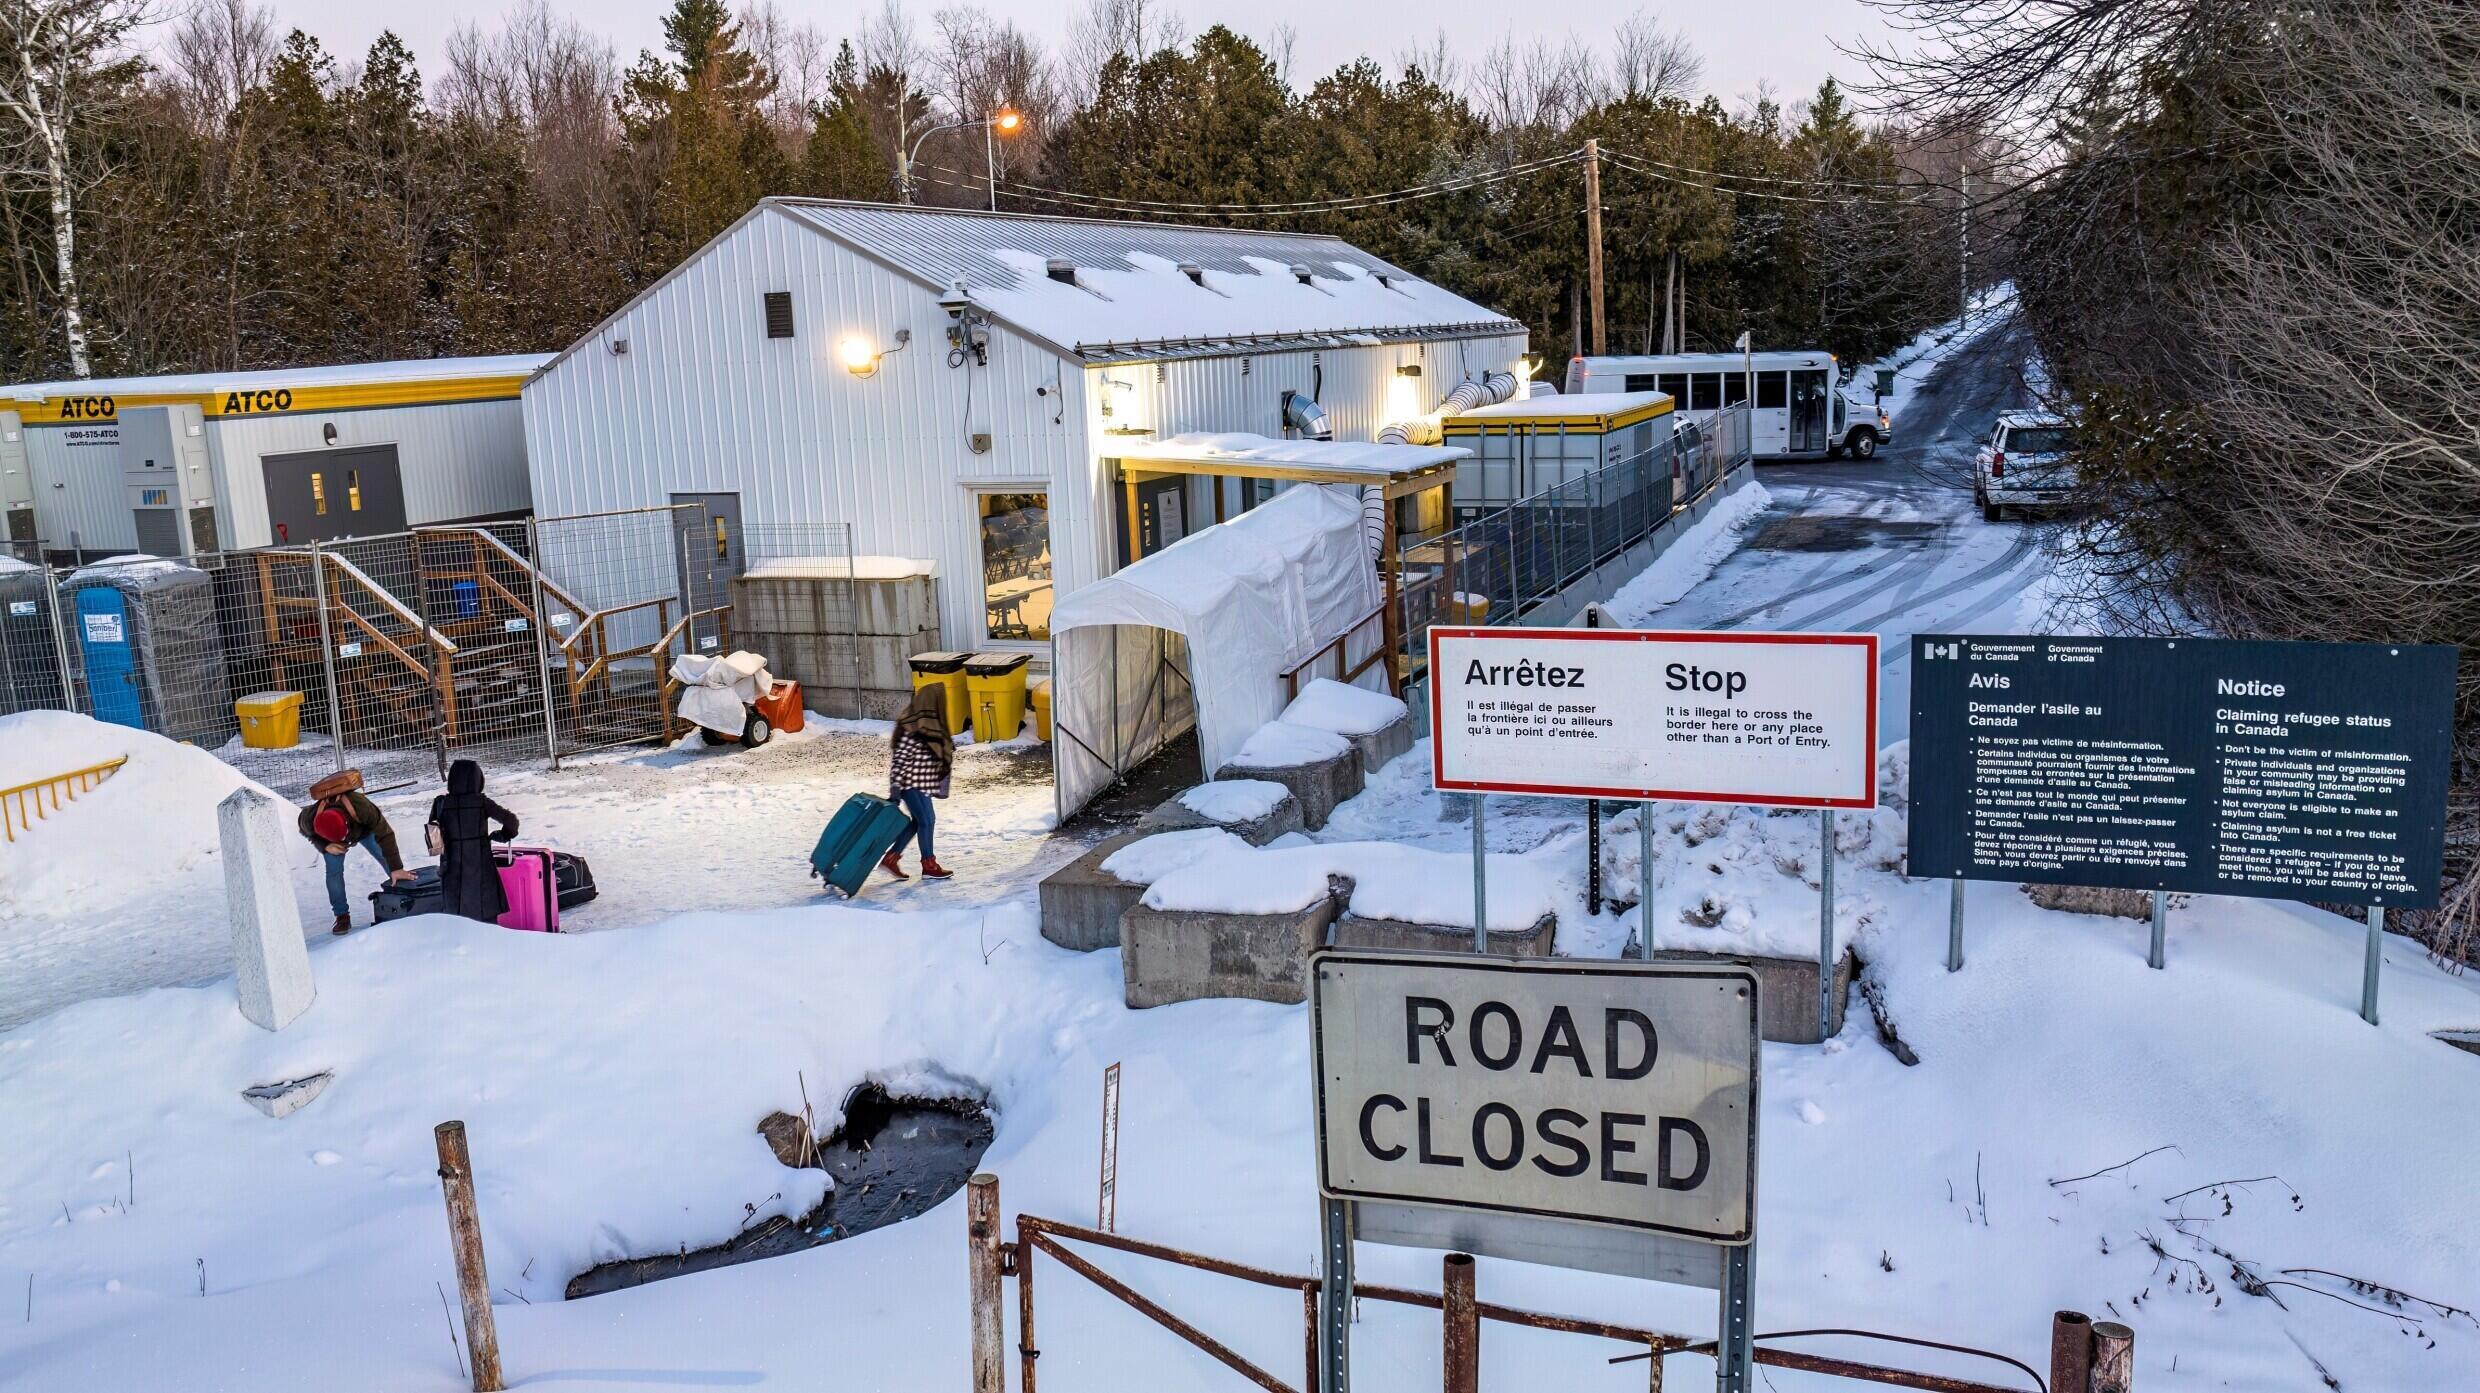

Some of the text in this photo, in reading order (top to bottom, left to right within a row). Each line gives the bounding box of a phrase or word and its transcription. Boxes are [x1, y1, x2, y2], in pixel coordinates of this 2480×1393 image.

[61, 396, 115, 418] ATCO
[224, 389, 292, 413] ATCO
[1970, 643, 2035, 651] Gouvernement
[2047, 644, 2102, 653] Government
[1970, 652, 2018, 660] du Canada
[2047, 653, 2094, 661] of Canada
[1464, 658, 1585, 687] Arrêtez
[1968, 672, 2010, 688] Avis
[1665, 663, 1747, 699] Stop
[2217, 678, 2285, 696] Notice
[1467, 700, 1596, 714] Il est illégal de passer
[1666, 706, 1812, 719] It is illegal to cross the
[1968, 701, 2101, 714] Demander l'asile au
[1467, 712, 1476, 721] la
[1481, 713, 1528, 723] frontière
[1534, 714, 1546, 723] ici
[1571, 716, 1612, 725] ailleurs
[1968, 714, 2017, 726] Canada
[2216, 708, 2391, 726] Claiming refugee status
[1467, 725, 1491, 736] qu'à
[1515, 726, 1543, 737] point
[1548, 727, 1597, 738] d'entrée.
[1666, 719, 1706, 729] border
[1711, 720, 1738, 730] here
[1761, 724, 1783, 734] any
[1789, 723, 1822, 734] place
[2215, 722, 2288, 735] in Canada
[1666, 732, 1697, 741] other
[1702, 732, 1728, 742] than
[1747, 734, 1772, 744] Port
[1777, 735, 1789, 744] of
[1795, 736, 1830, 748] Entry.
[1977, 735, 1990, 743] Ne
[1993, 737, 2019, 745] soyez
[2022, 738, 2038, 746] pas
[2041, 738, 2073, 746] victime
[2091, 740, 2164, 750] mésinformation.
[1977, 748, 2014, 757] Certains
[2017, 750, 2057, 758] individus
[2074, 753, 2127, 762] organismes
[2130, 754, 2142, 762] de
[2225, 744, 2411, 761] Don't be the victim of misinformation.
[2224, 758, 2405, 775] Private individuals and organizations
[1976, 774, 2000, 782] d'une
[2003, 775, 2044, 784] demande
[2047, 777, 2076, 786] d'asile
[2094, 780, 2131, 788] Canada.
[2223, 776, 2246, 784] false
[2263, 778, 2315, 790] misleading
[2319, 781, 2374, 792] information
[2236, 769, 2258, 777] your
[2260, 771, 2313, 781] community
[2317, 774, 2338, 782] may
[2341, 773, 2354, 781] be
[2358, 775, 2405, 786] providing
[2222, 785, 2262, 796] claiming
[2265, 788, 2300, 798] asylum
[2316, 790, 2356, 800] Canada.
[1995, 797, 2035, 806] demande
[2038, 799, 2067, 807] d'asile
[2085, 801, 2122, 810] Canada.
[2222, 798, 2239, 807] Not
[2242, 801, 2286, 810] everyone
[2289, 802, 2298, 810] is
[2301, 803, 2337, 813] eligible
[2354, 807, 2381, 815] make
[1975, 809, 2020, 818] Demander
[2023, 811, 2048, 820] l'asile
[2052, 813, 2073, 821] n'est
[2111, 815, 2176, 826] laissez-passer
[2221, 809, 2286, 819] asylum claim.
[1989, 818, 2024, 827] Canada.
[2220, 821, 2262, 833] Claiming
[2265, 825, 2300, 834] asylum
[2303, 826, 2312, 834] is
[2345, 828, 2365, 837] free
[2368, 830, 2396, 839] ticket
[2220, 830, 2280, 841] into Canada.
[2219, 844, 2246, 852] There
[2269, 848, 2306, 857] specific
[2309, 851, 2374, 861] requirements
[1999, 859, 2019, 867] pays
[2022, 859, 2063, 869] d'origine.
[2231, 871, 2244, 879] be
[2247, 874, 2288, 882] removed
[2305, 878, 2327, 886] your
[2330, 880, 2368, 890] country
[2371, 881, 2382, 889] of
[2385, 882, 2417, 892] origin.
[1406, 996, 1658, 1080] ROAD
[1358, 1093, 1711, 1191] CLOSED
